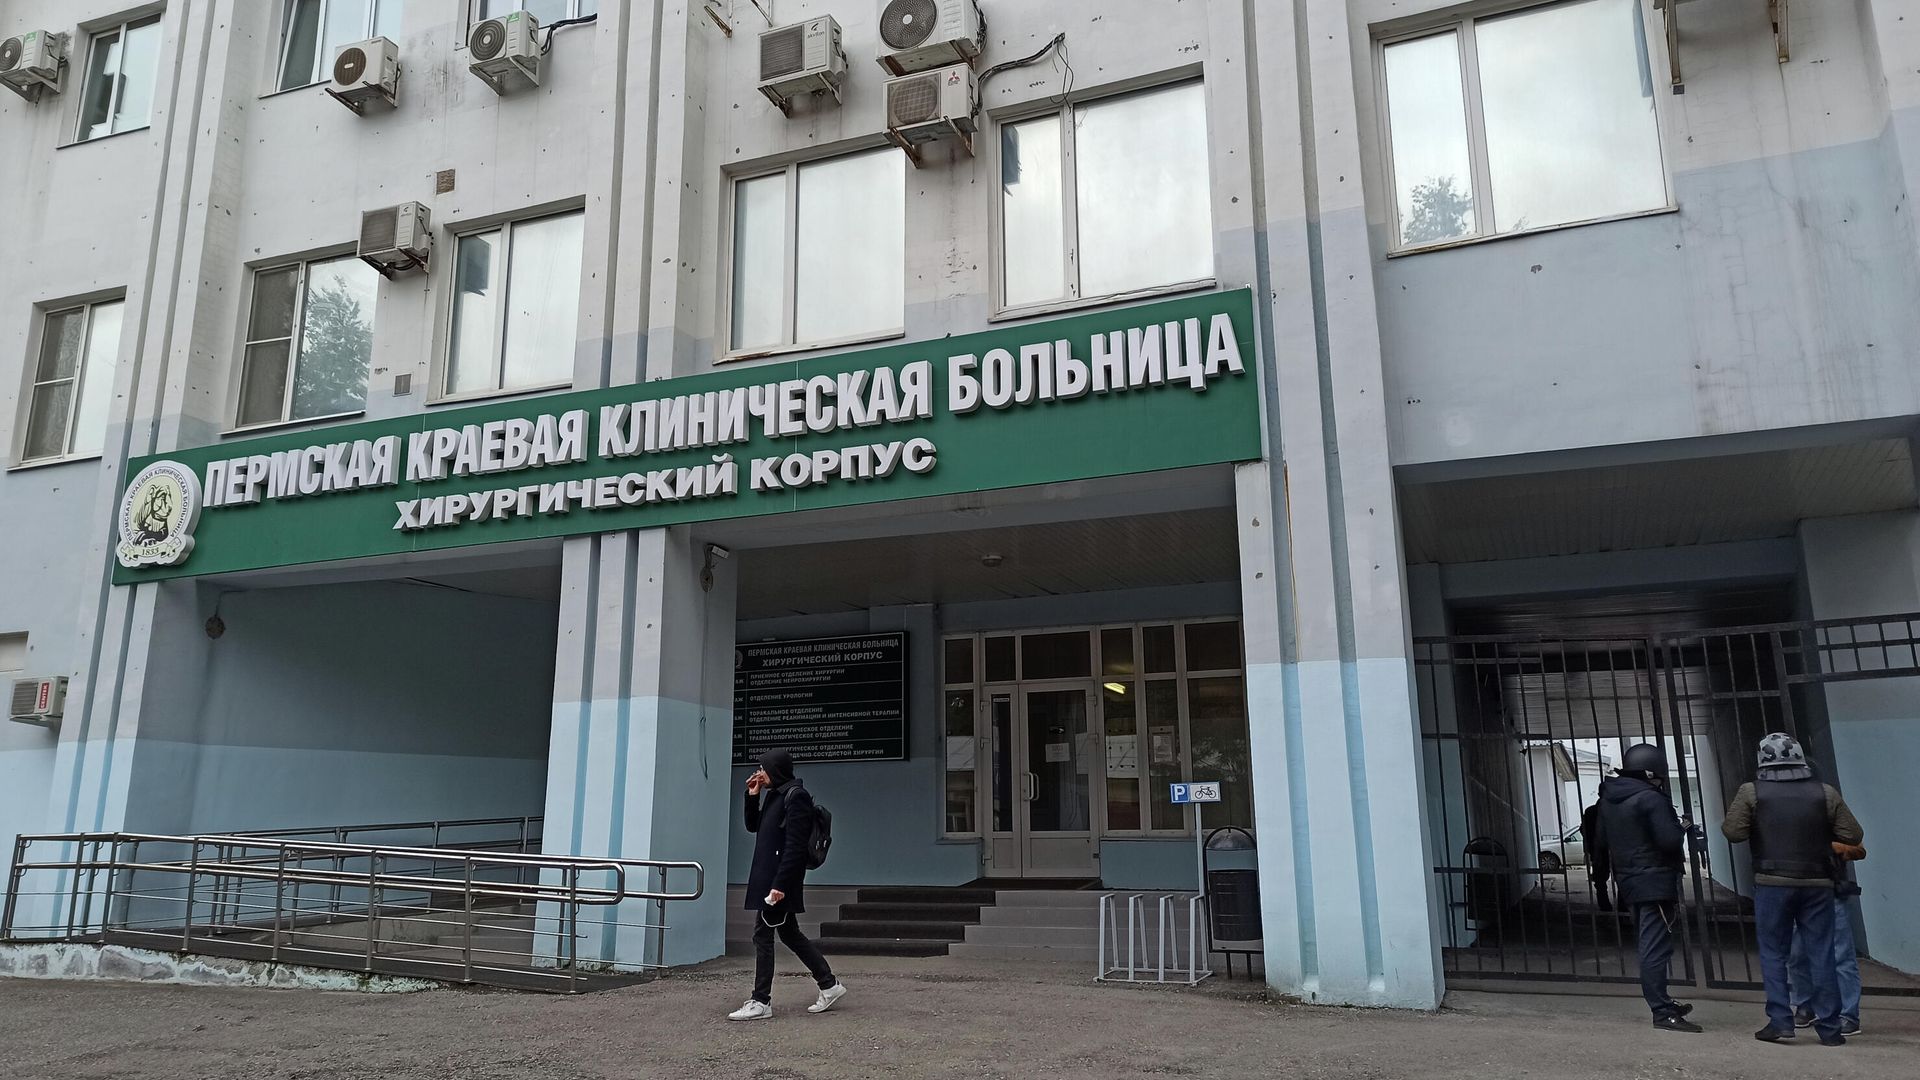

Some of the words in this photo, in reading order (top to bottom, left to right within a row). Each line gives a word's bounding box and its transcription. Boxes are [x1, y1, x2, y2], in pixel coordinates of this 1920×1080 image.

[202, 434, 401, 508] ПЕРМСКАЯ
[405, 409, 590, 484] КРАЕВАЯ
[598, 360, 933, 460] КЛИНИЧЕСКАЯ
[948, 313, 1246, 415] БОЛЬНИЦА
[391, 452, 739, 532] ХИРУРГИЧЕСКИЙ
[750, 437, 937, 491] КОРПУС
[141, 548, 160, 556] 1833
[748, 647, 782, 657] ПЕРМСКАЯ
[784, 645, 812, 654] КРАЕВАЯ
[814, 640, 860, 652] КЛИНИЧЕСКАЯ
[862, 638, 898, 650] БОЛЬНИЦА
[762, 652, 840, 667] ХИРУРГИЧЕСКИЙ
[844, 652, 883, 661] КОРПУС
[749, 732, 814, 741] ТРАВМАТОЛОГИЧЕСКОЕ
[771, 726, 818, 734] ХИРУРГИЧЕСКОЕ
[1174, 785, 1186, 800] P
